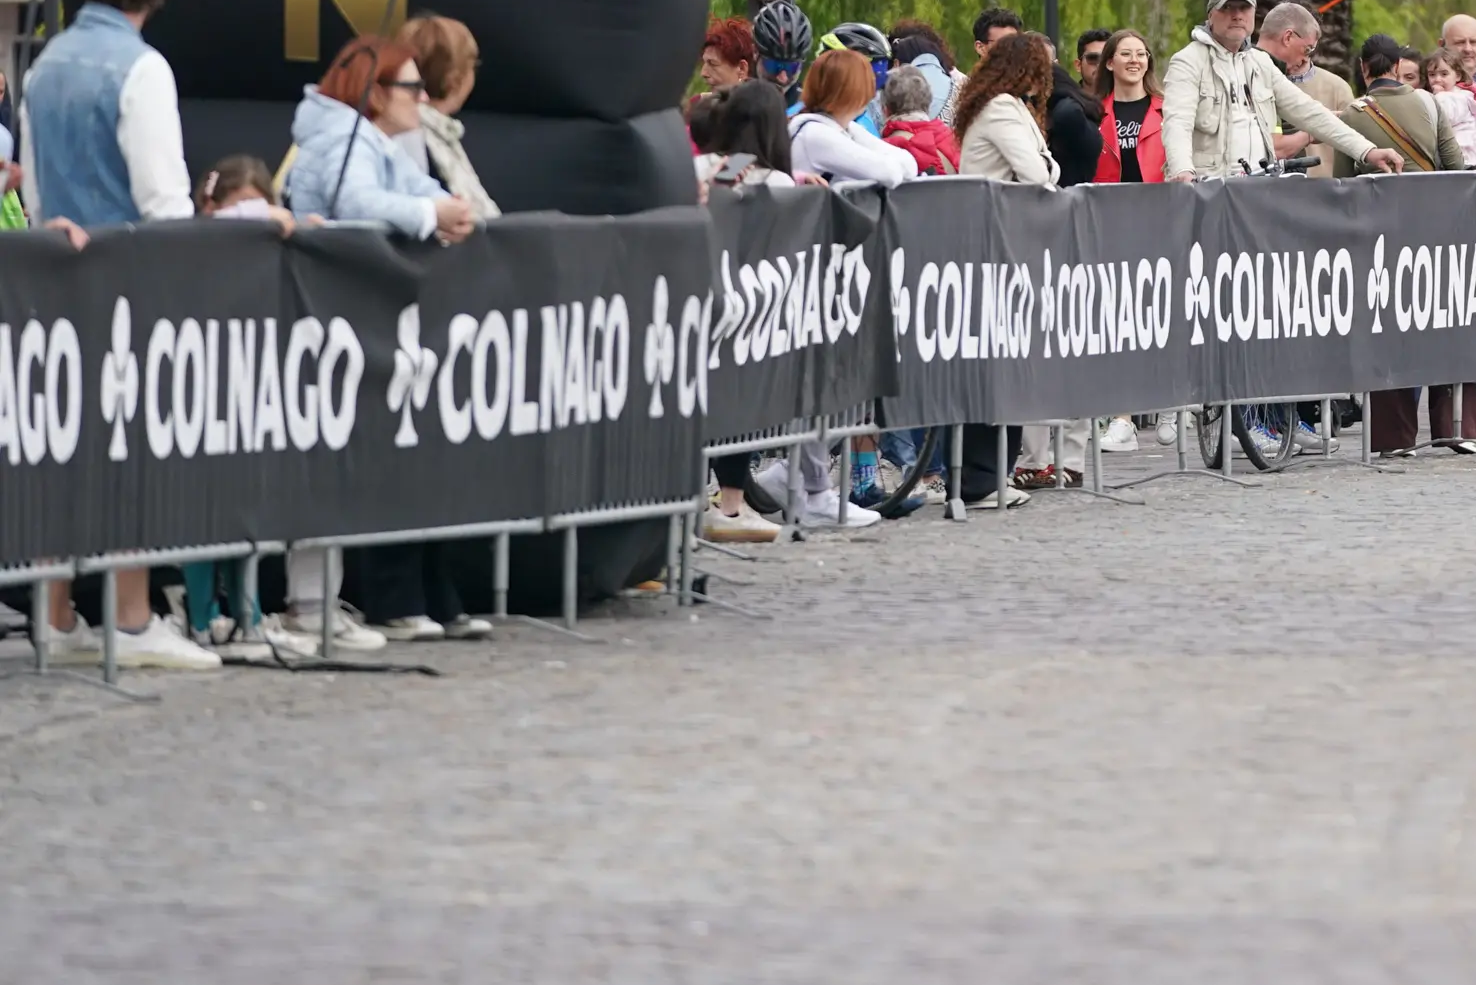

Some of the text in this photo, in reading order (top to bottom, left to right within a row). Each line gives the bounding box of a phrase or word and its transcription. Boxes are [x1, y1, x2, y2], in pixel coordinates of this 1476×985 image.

[733, 243, 871, 366] COLNAGO
[916, 260, 1035, 363] COLNAGO
[1057, 256, 1173, 358] COLNAGO
[1214, 247, 1354, 343] COLNAGO
[144, 316, 365, 460] COLNAGO
[438, 292, 631, 445] COLNAGO
